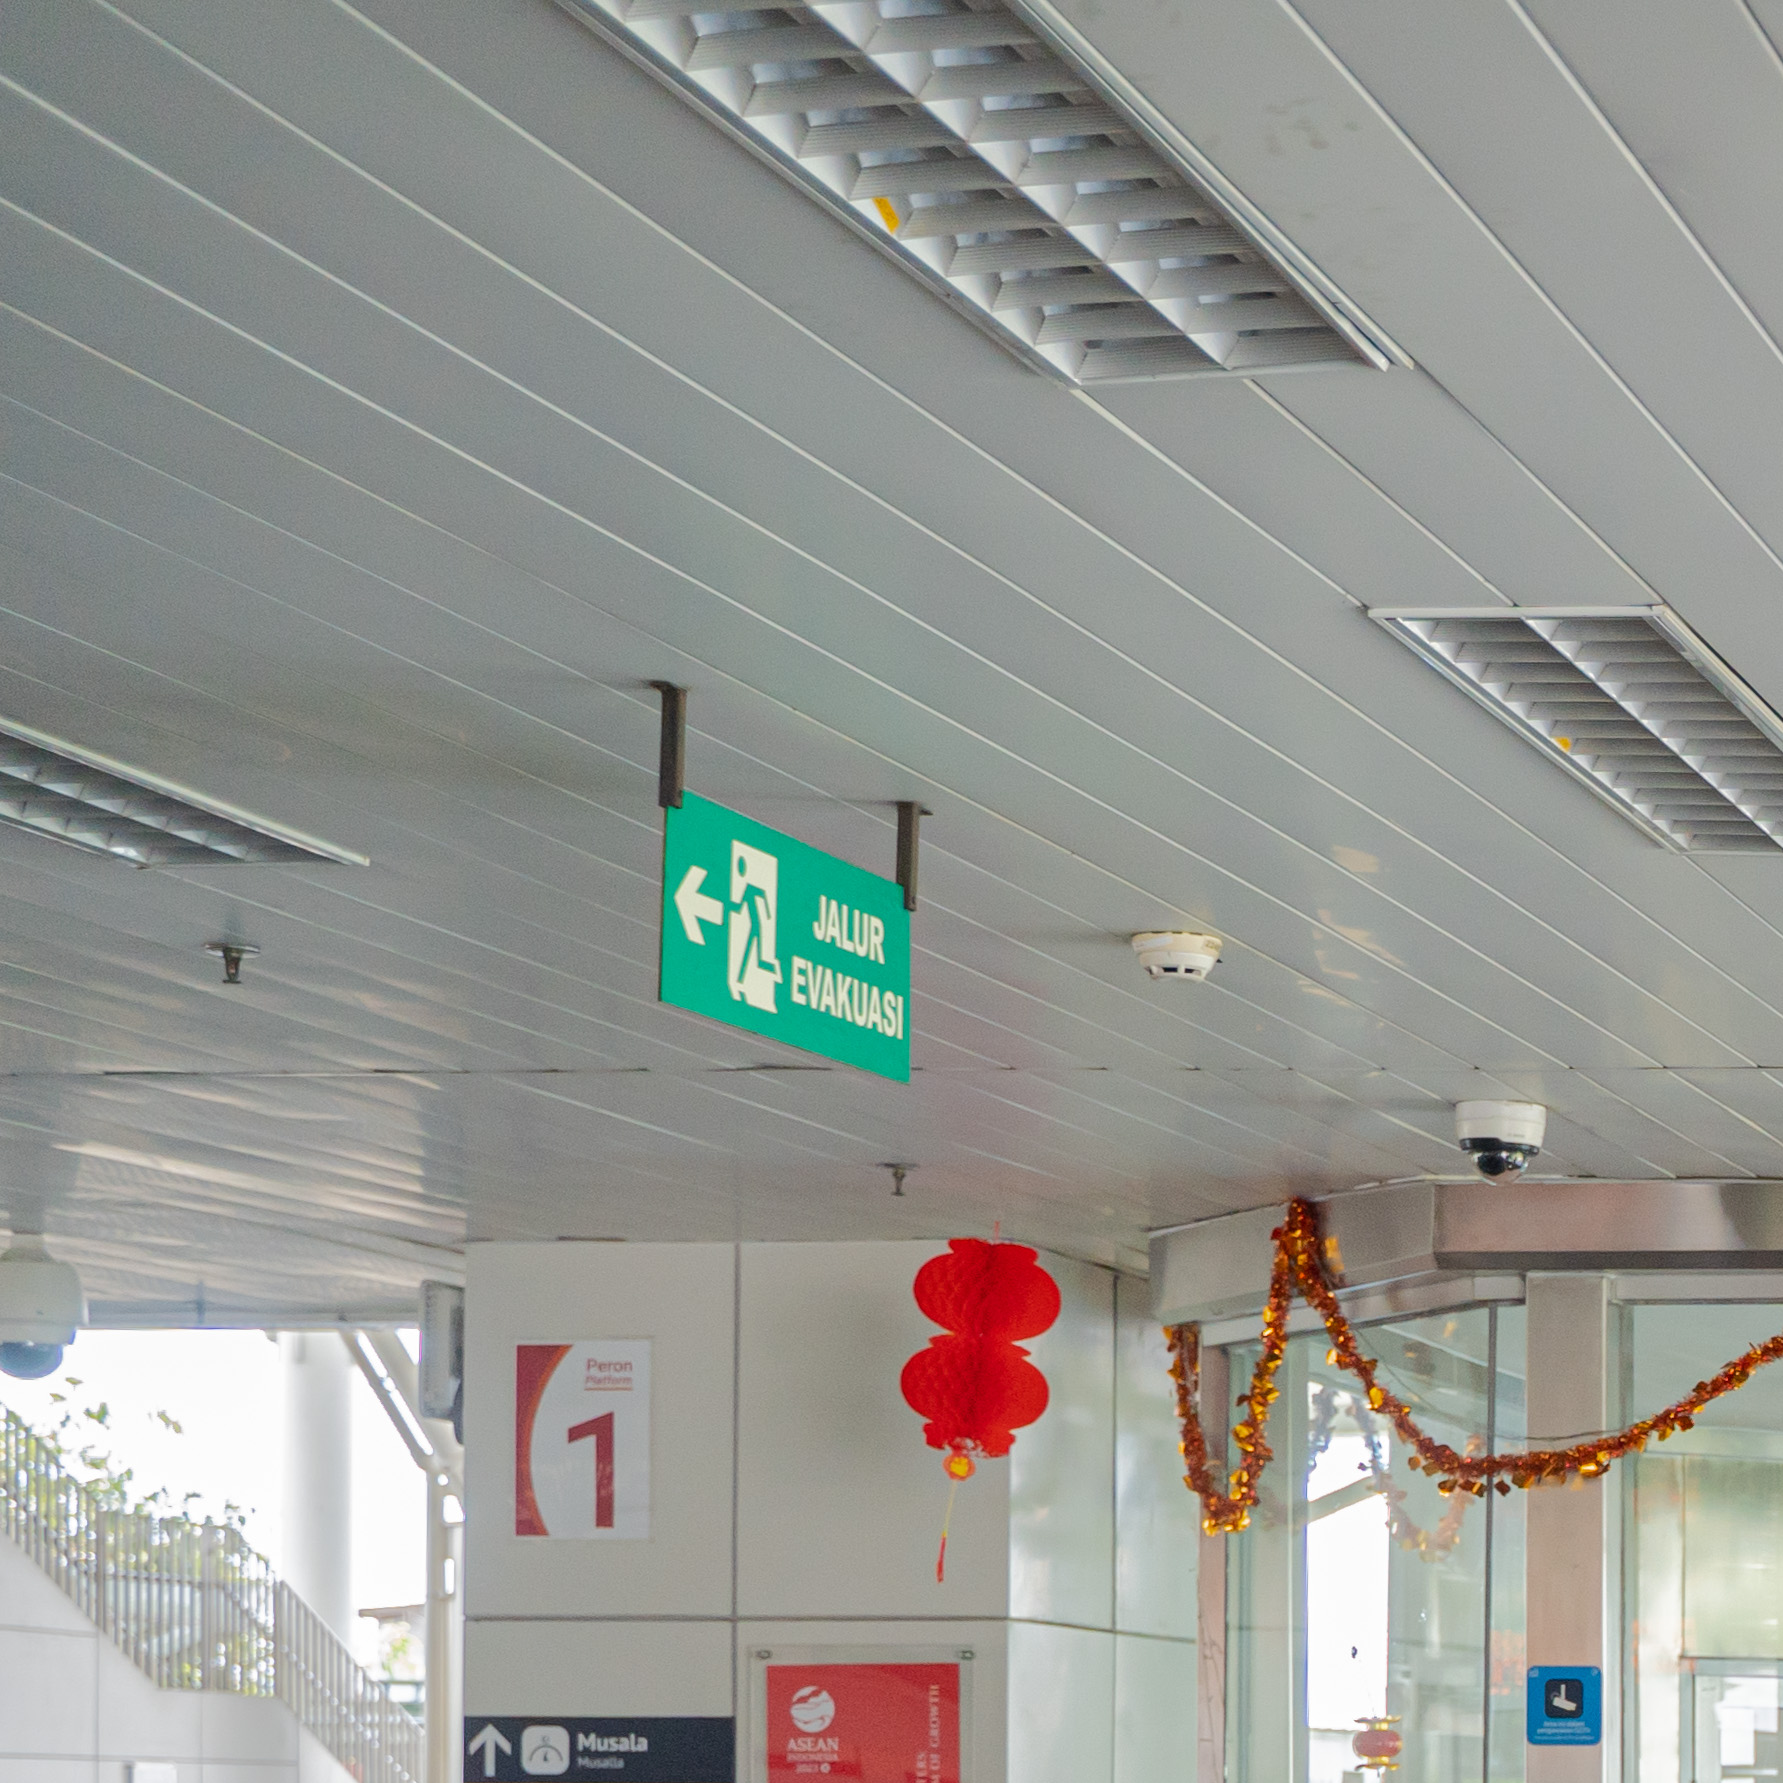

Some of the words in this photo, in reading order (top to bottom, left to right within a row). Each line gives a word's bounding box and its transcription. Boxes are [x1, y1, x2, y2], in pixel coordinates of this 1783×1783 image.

[813, 895, 885, 965] JALUR
[791, 955, 904, 1040] EVAKUASI
[587, 1358, 633, 1373] Peron
[584, 1376, 633, 1386] Platform
[567, 1411, 615, 1528] 1
[577, 1732, 649, 1753] Musala
[786, 1737, 839, 1752] ASEAN
[577, 1756, 625, 1770] Musalla
